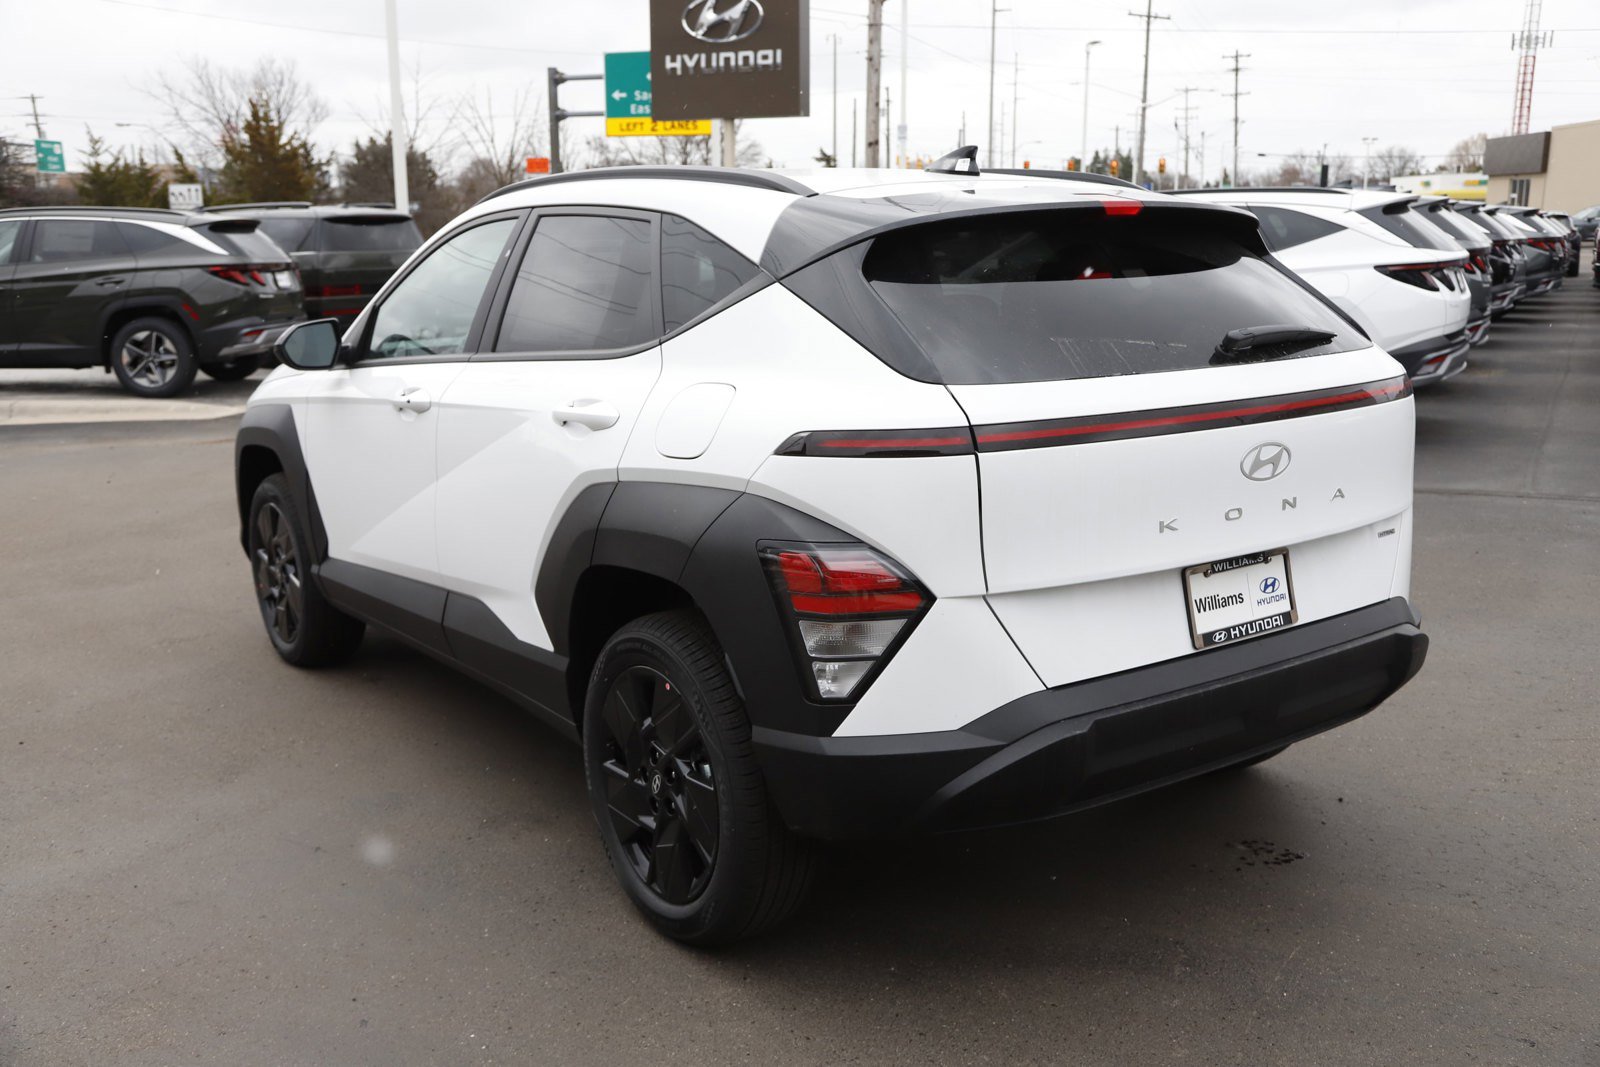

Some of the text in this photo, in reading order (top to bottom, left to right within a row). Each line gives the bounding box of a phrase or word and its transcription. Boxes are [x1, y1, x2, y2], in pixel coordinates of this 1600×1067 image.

[665, 48, 783, 76] HYUNDAI
[619, 119, 699, 132] LEFT 2 LANES
[1159, 487, 1346, 534] KONA
[1194, 592, 1245, 614] Williams
[1256, 593, 1287, 607] HYUNDAI
[1230, 615, 1284, 639] HYUNDAI
